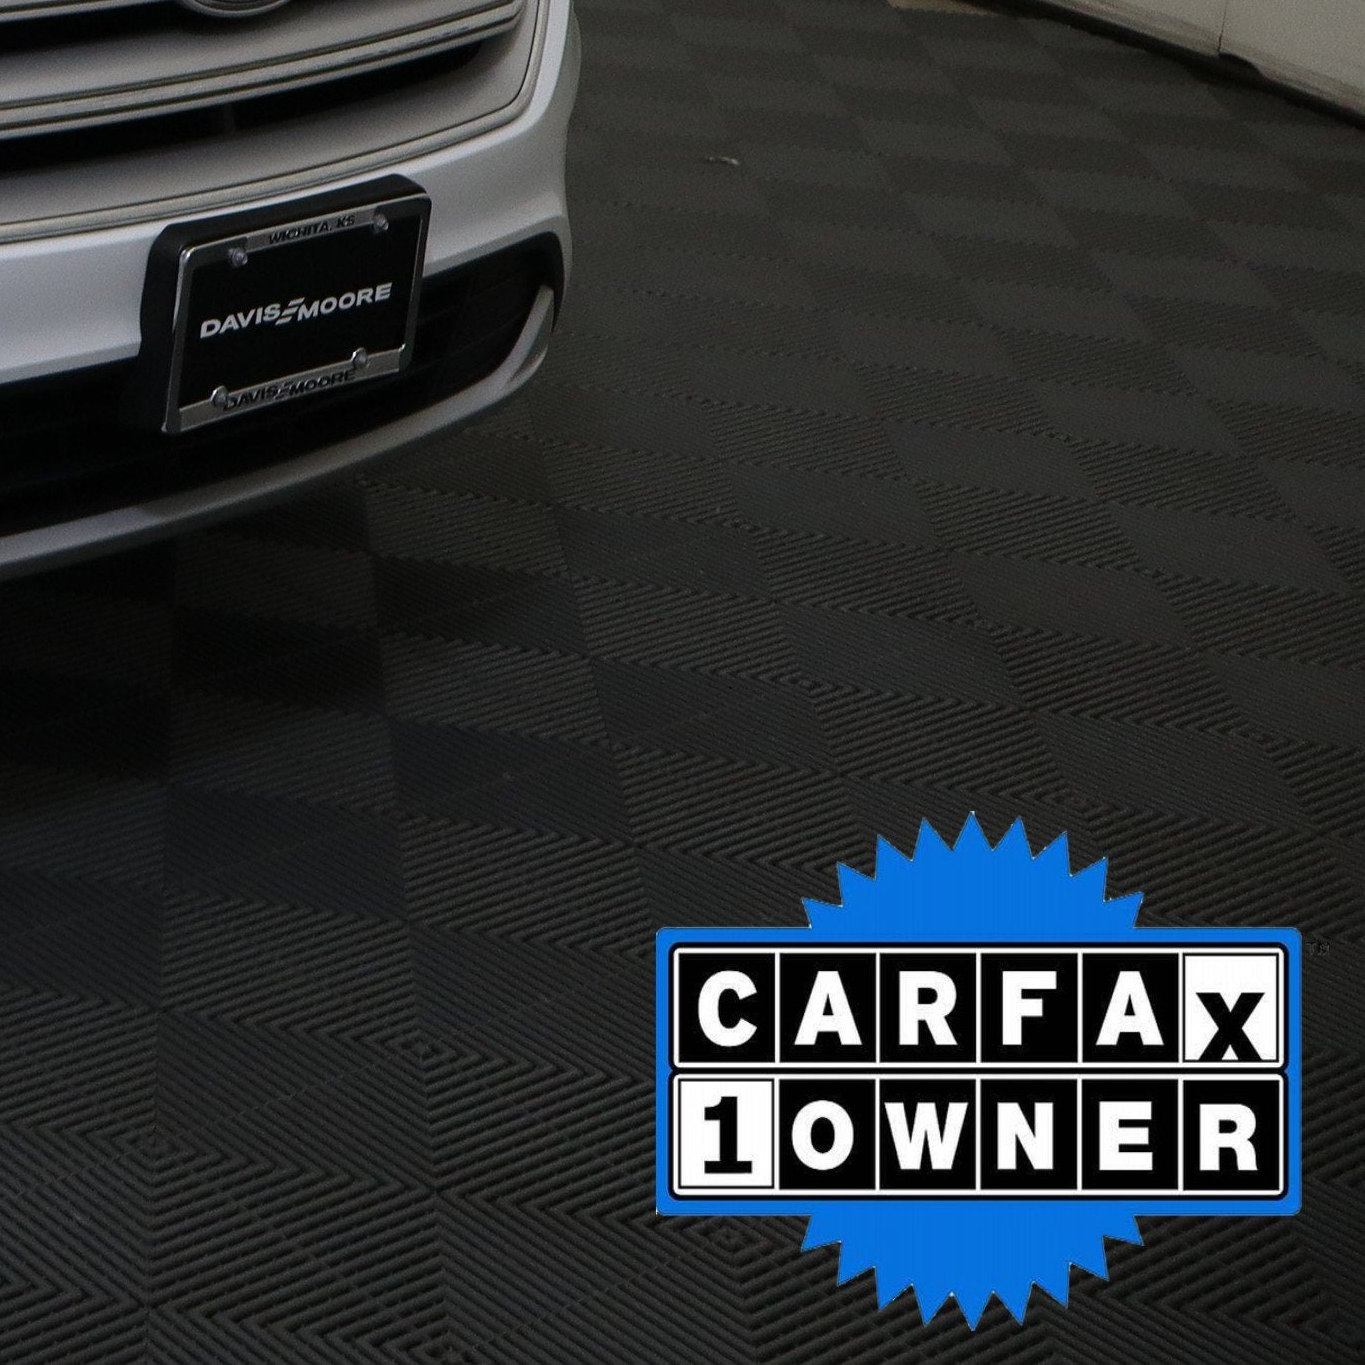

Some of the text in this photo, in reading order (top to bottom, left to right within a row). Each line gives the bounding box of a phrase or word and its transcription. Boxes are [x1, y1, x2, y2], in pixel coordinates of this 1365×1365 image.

[337, 214, 356, 228] KS
[200, 282, 393, 339] DAVIS MOORE
